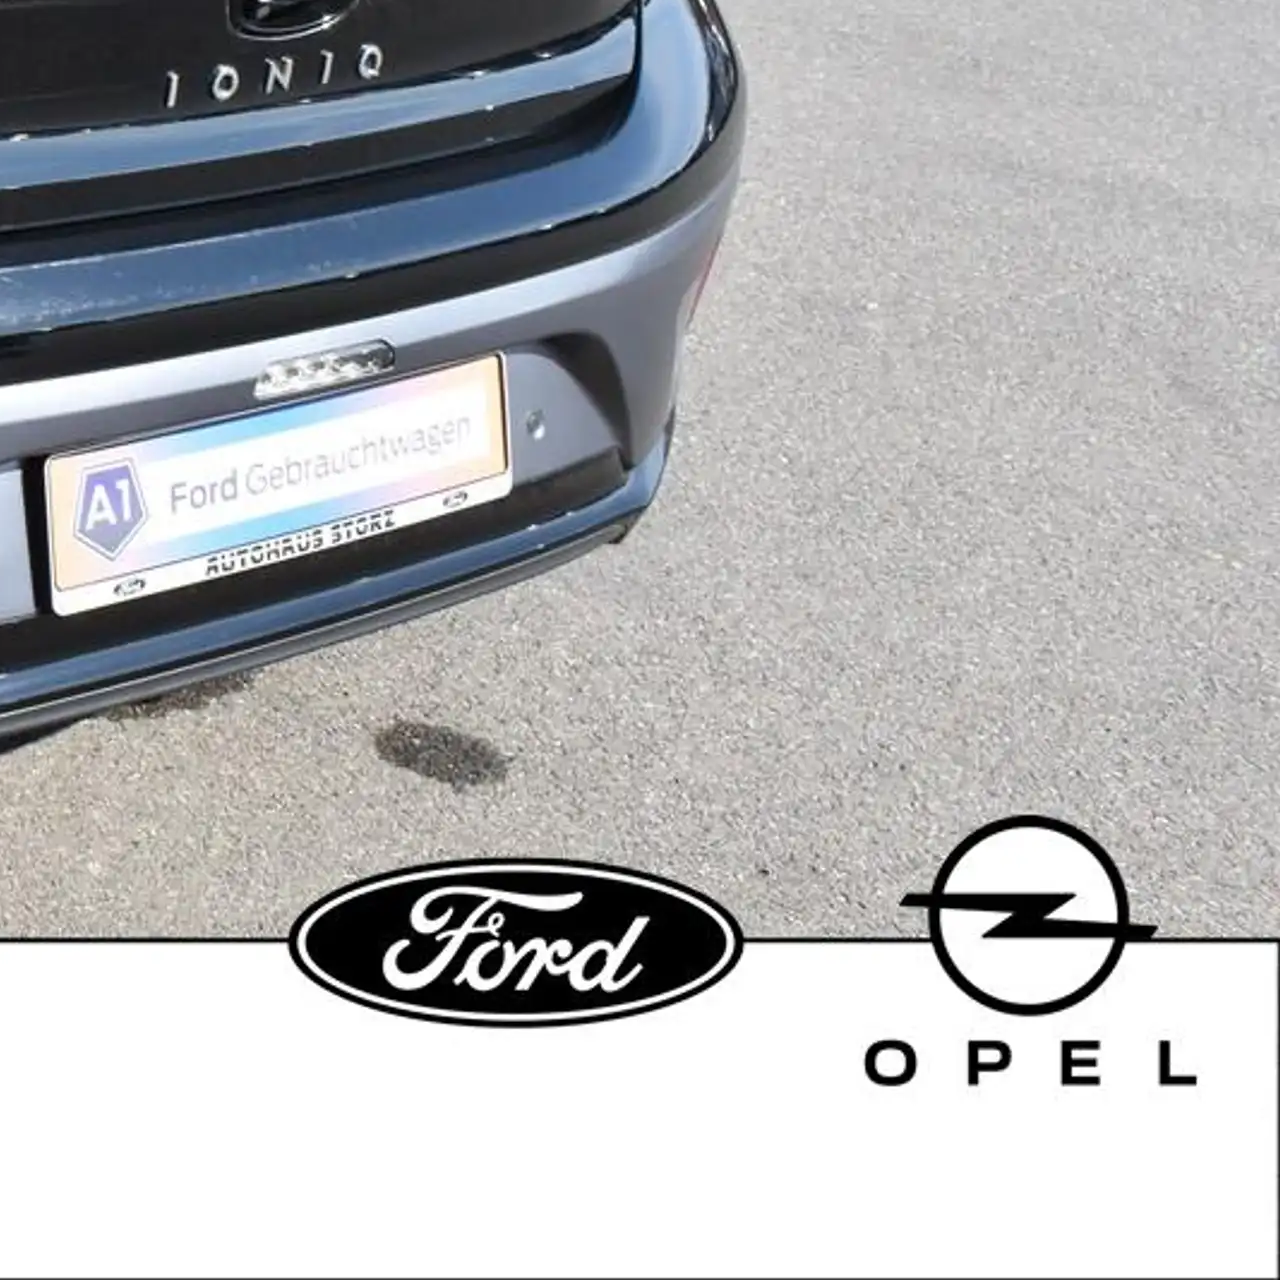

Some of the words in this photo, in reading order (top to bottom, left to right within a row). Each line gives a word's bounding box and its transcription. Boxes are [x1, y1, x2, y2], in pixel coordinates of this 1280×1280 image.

[164, 42, 385, 109] IONIQ
[170, 467, 238, 515] Ford
[244, 415, 471, 497] Gebrauchtwagen
[85, 477, 133, 531] A1
[204, 528, 325, 577] AUTOHAUS
[329, 508, 396, 545] STORZ
